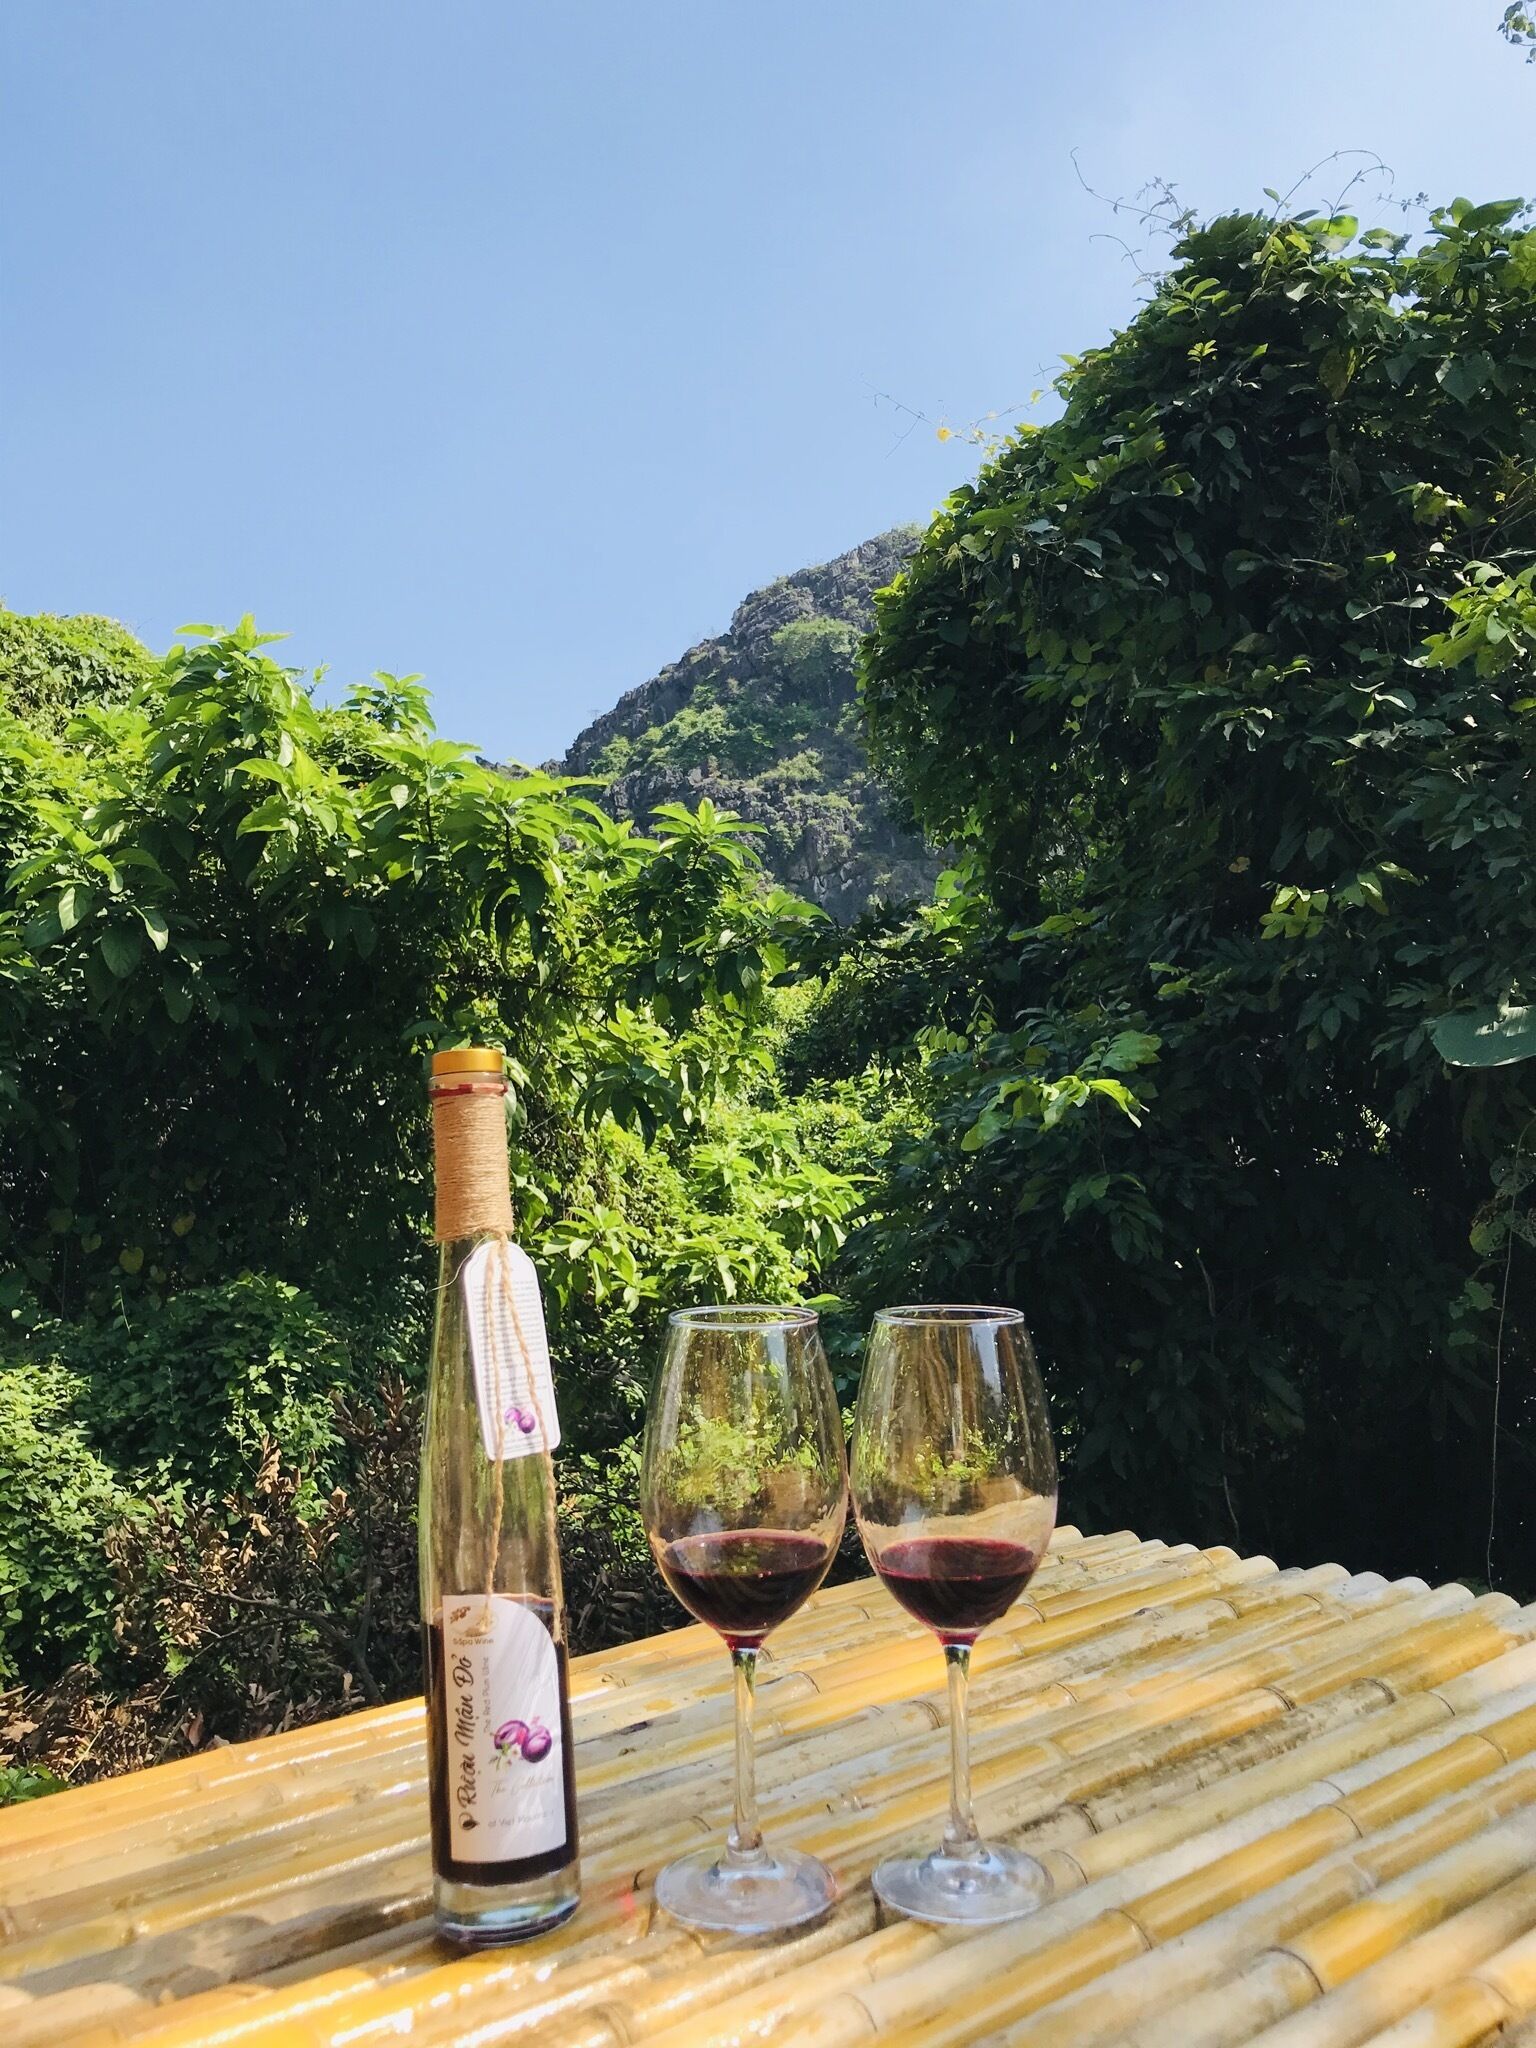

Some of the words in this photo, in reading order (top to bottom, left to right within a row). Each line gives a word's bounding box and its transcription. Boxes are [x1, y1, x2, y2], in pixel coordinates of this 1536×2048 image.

[474, 1637, 494, 1645] Wine
[451, 1654, 474, 1687] Đỏ
[454, 1693, 478, 1746] Mận
